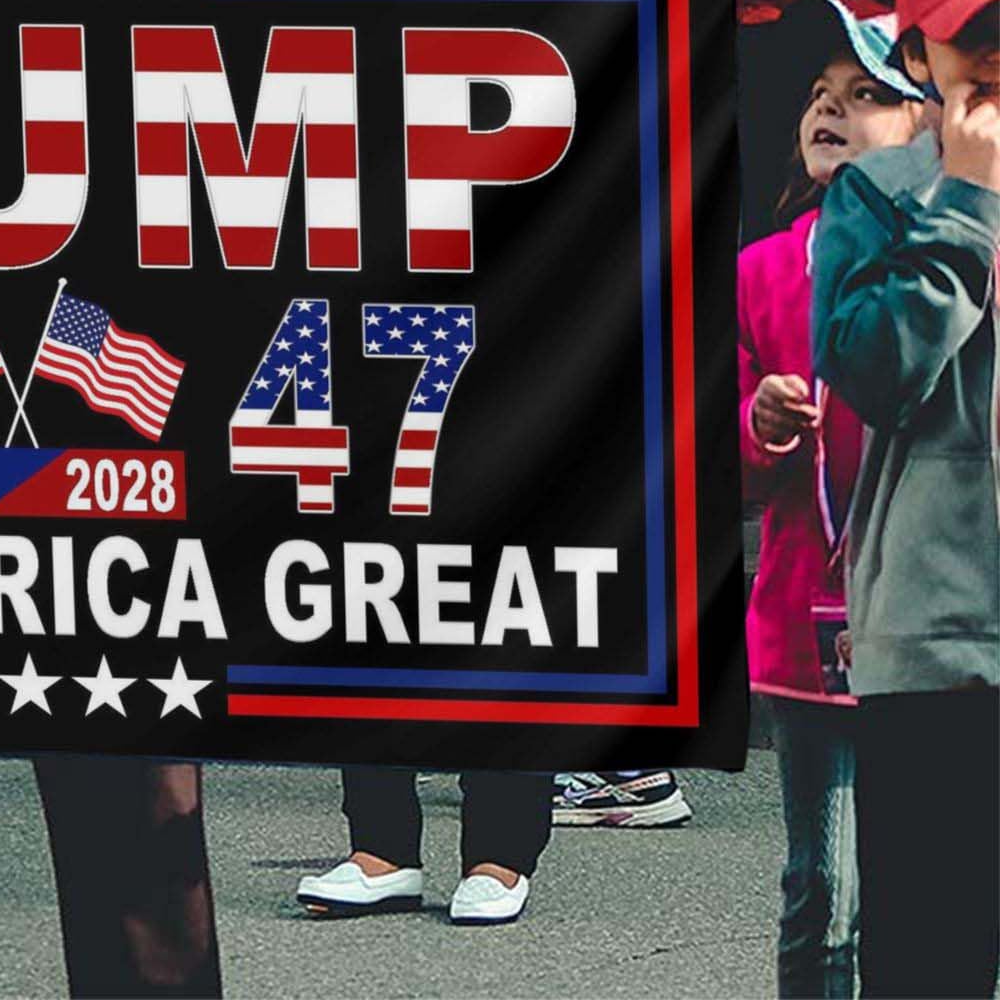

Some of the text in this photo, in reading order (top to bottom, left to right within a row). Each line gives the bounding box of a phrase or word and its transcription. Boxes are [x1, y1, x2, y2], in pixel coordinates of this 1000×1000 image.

[229, 298, 476, 516] 47
[65, 458, 176, 512] 2028
[264, 539, 618, 648] GREAT
